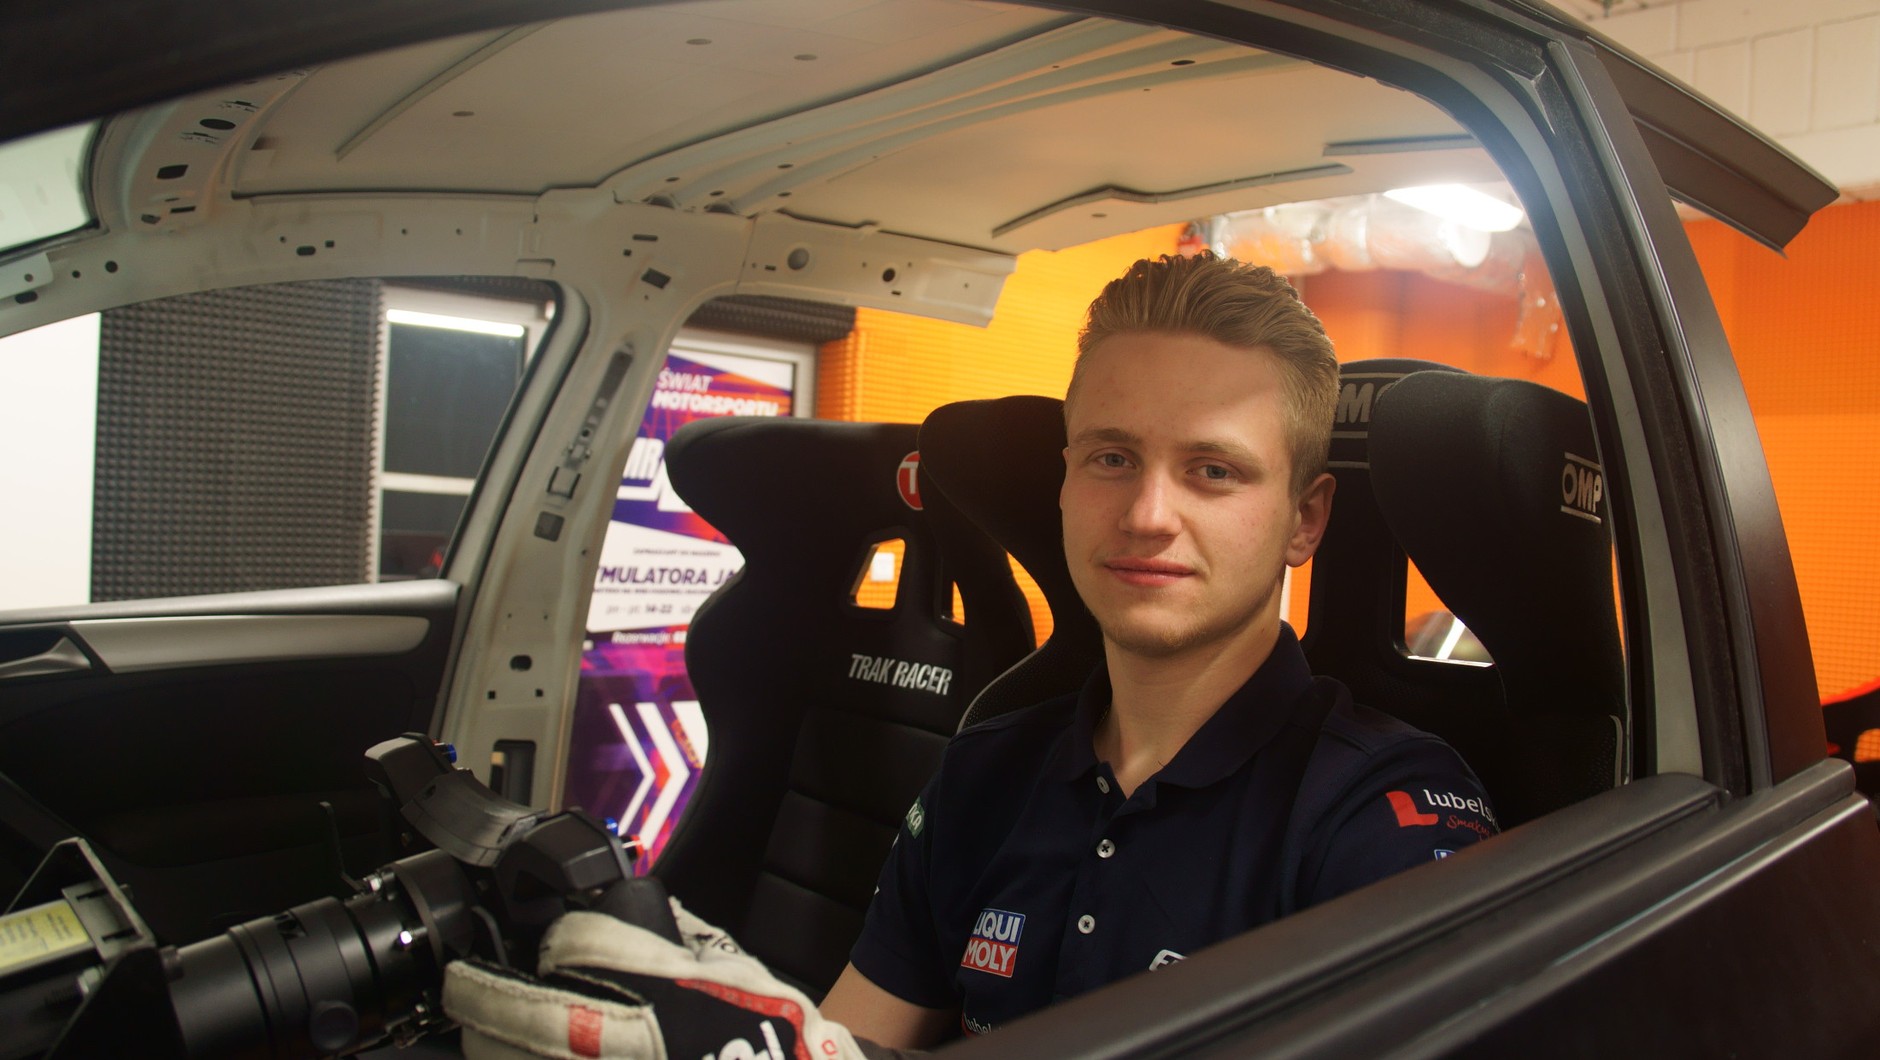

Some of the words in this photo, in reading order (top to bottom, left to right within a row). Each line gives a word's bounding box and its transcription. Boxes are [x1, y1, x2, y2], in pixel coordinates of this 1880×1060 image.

[657, 366, 713, 394] ŚWIAT
[651, 389, 779, 417] MOTORSPORTU
[1561, 462, 1603, 513] OMP
[599, 565, 708, 586] MULATORA
[848, 653, 896, 684] TRAK
[891, 660, 953, 696] RACER
[972, 910, 1021, 943] LIQUI
[962, 939, 1016, 973] MOLY
